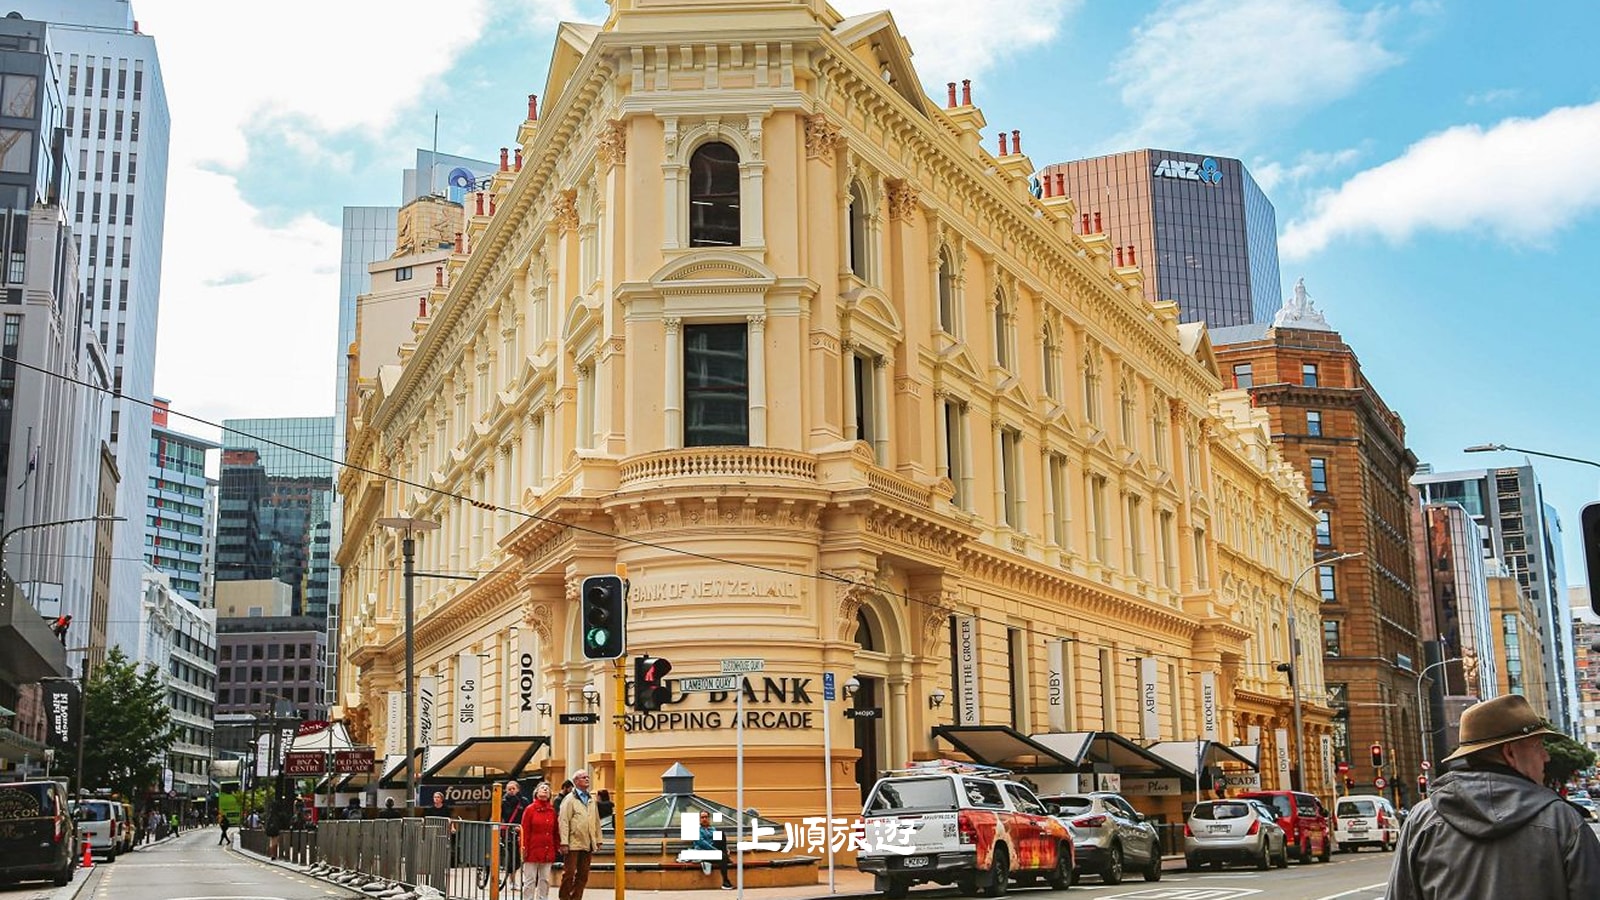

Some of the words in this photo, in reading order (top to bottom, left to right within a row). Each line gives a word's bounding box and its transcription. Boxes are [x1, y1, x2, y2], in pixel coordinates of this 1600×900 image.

[1153, 159, 1200, 181] ANZ
[632, 583, 667, 603] BANK
[669, 583, 689, 600] OF
[693, 580, 725, 599] NEW
[962, 620, 971, 662] GROCER
[460, 680, 475, 692] Co
[520, 653, 534, 713] MOJO
[684, 679, 714, 690] LAMBTON
[716, 677, 732, 689] QUAY
[964, 664, 973, 686] THE
[1049, 670, 1060, 706] RUBY
[1145, 683, 1155, 714] RUBY
[460, 703, 474, 723] Sills
[965, 687, 974, 722] SMITH
[1204, 685, 1213, 731] RICOCHET
[624, 711, 721, 732] SHOPPING
[731, 711, 813, 729] ARCADE
[1226, 776, 1258, 786] RCADE
[445, 786, 491, 801] foneb
